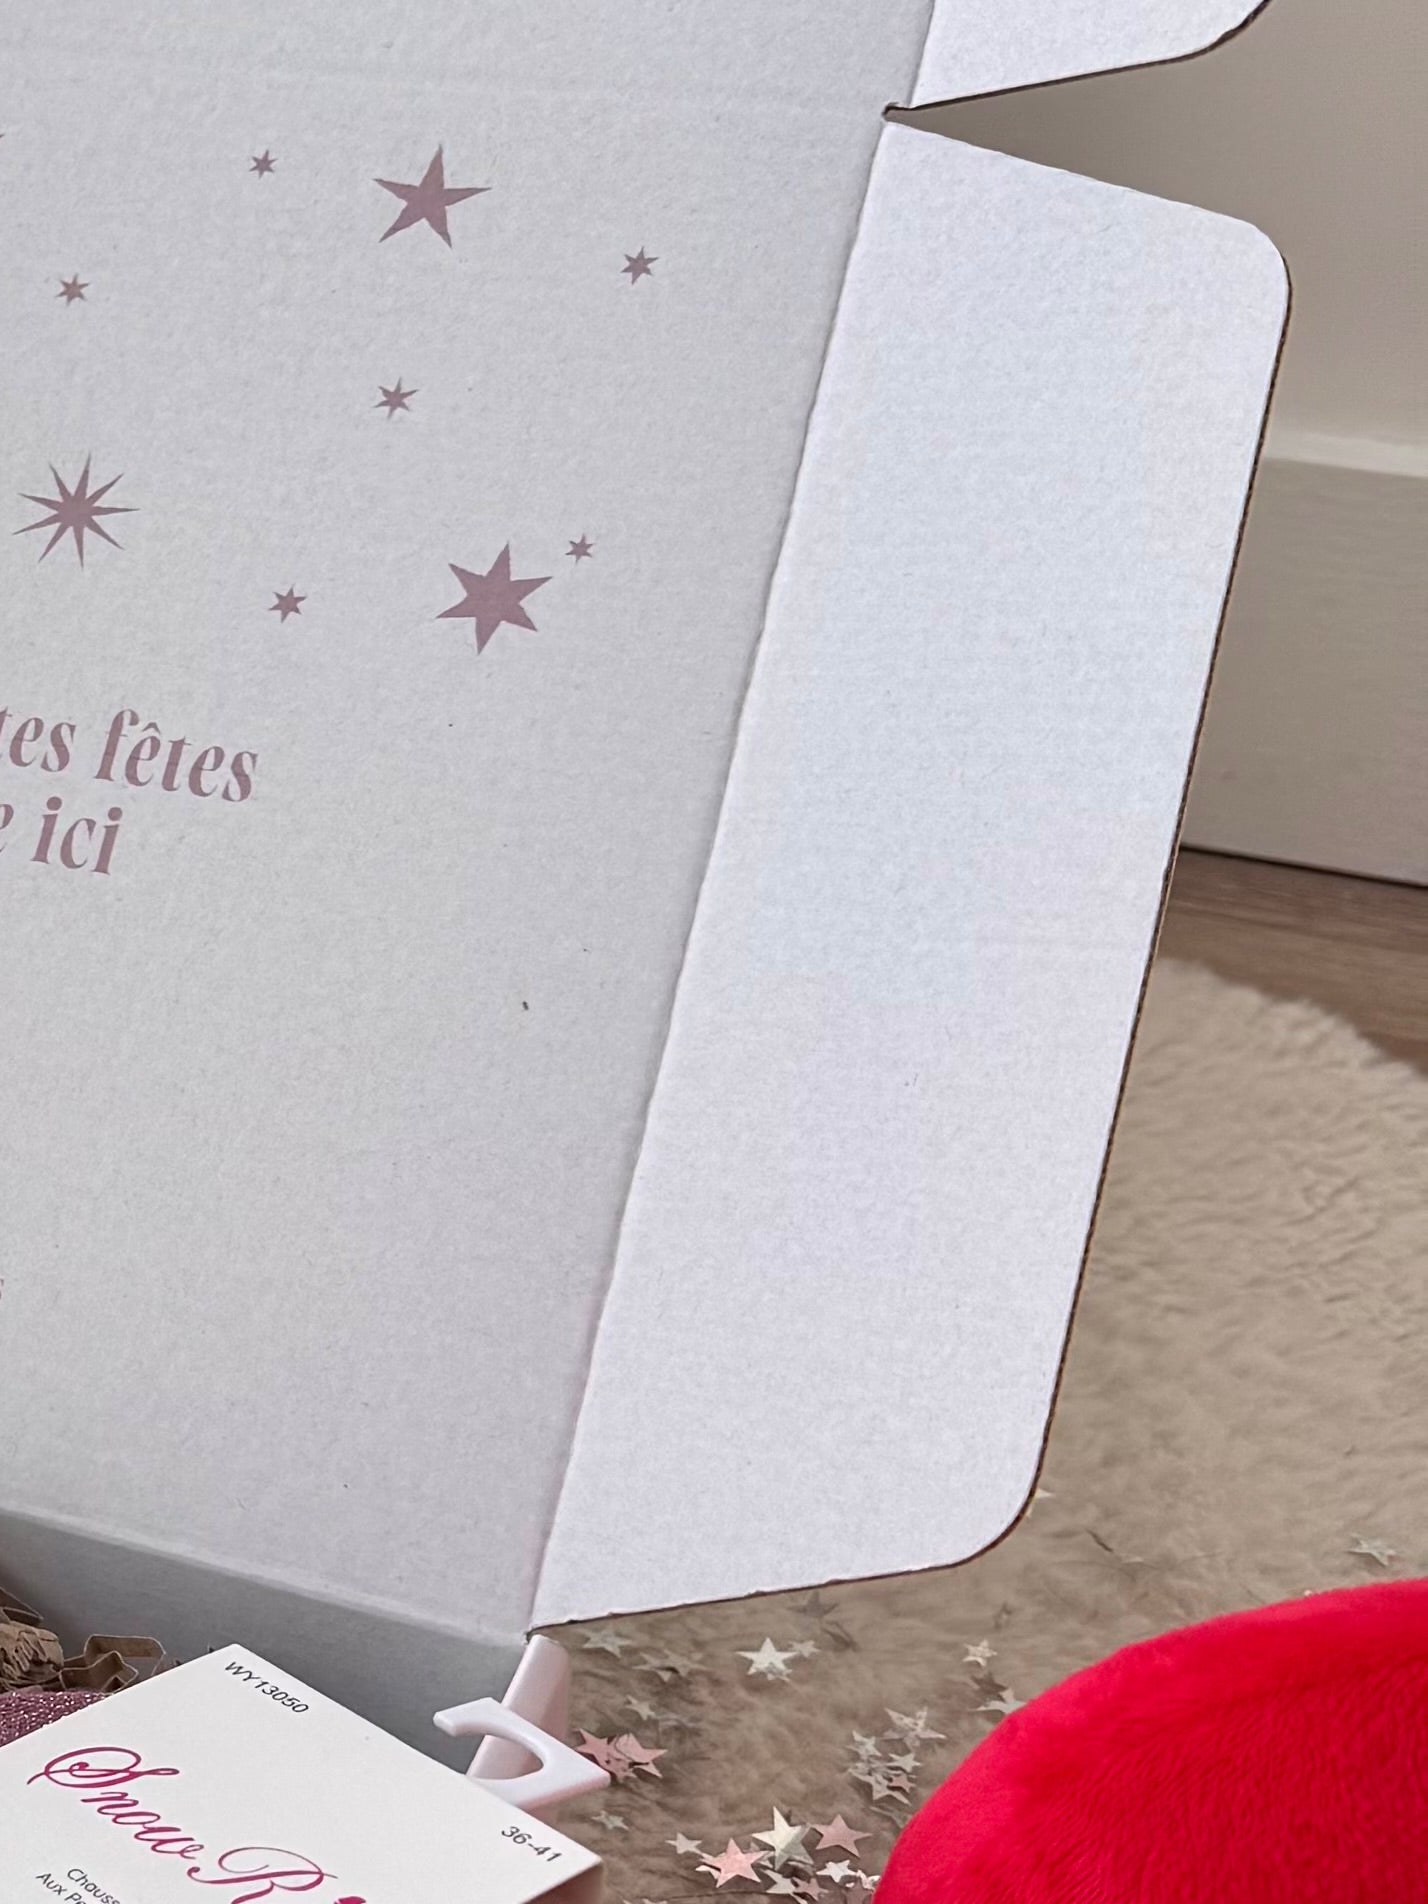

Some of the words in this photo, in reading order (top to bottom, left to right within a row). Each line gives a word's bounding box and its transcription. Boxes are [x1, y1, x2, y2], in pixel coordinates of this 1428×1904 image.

[93, 707, 259, 803] fêtes
[30, 796, 124, 876] ici
[224, 1661, 309, 1713] WY13050
[26, 1745, 204, 1860] Snow
[501, 1826, 562, 1862] 36-41
[35, 1873, 68, 1896] Aux
